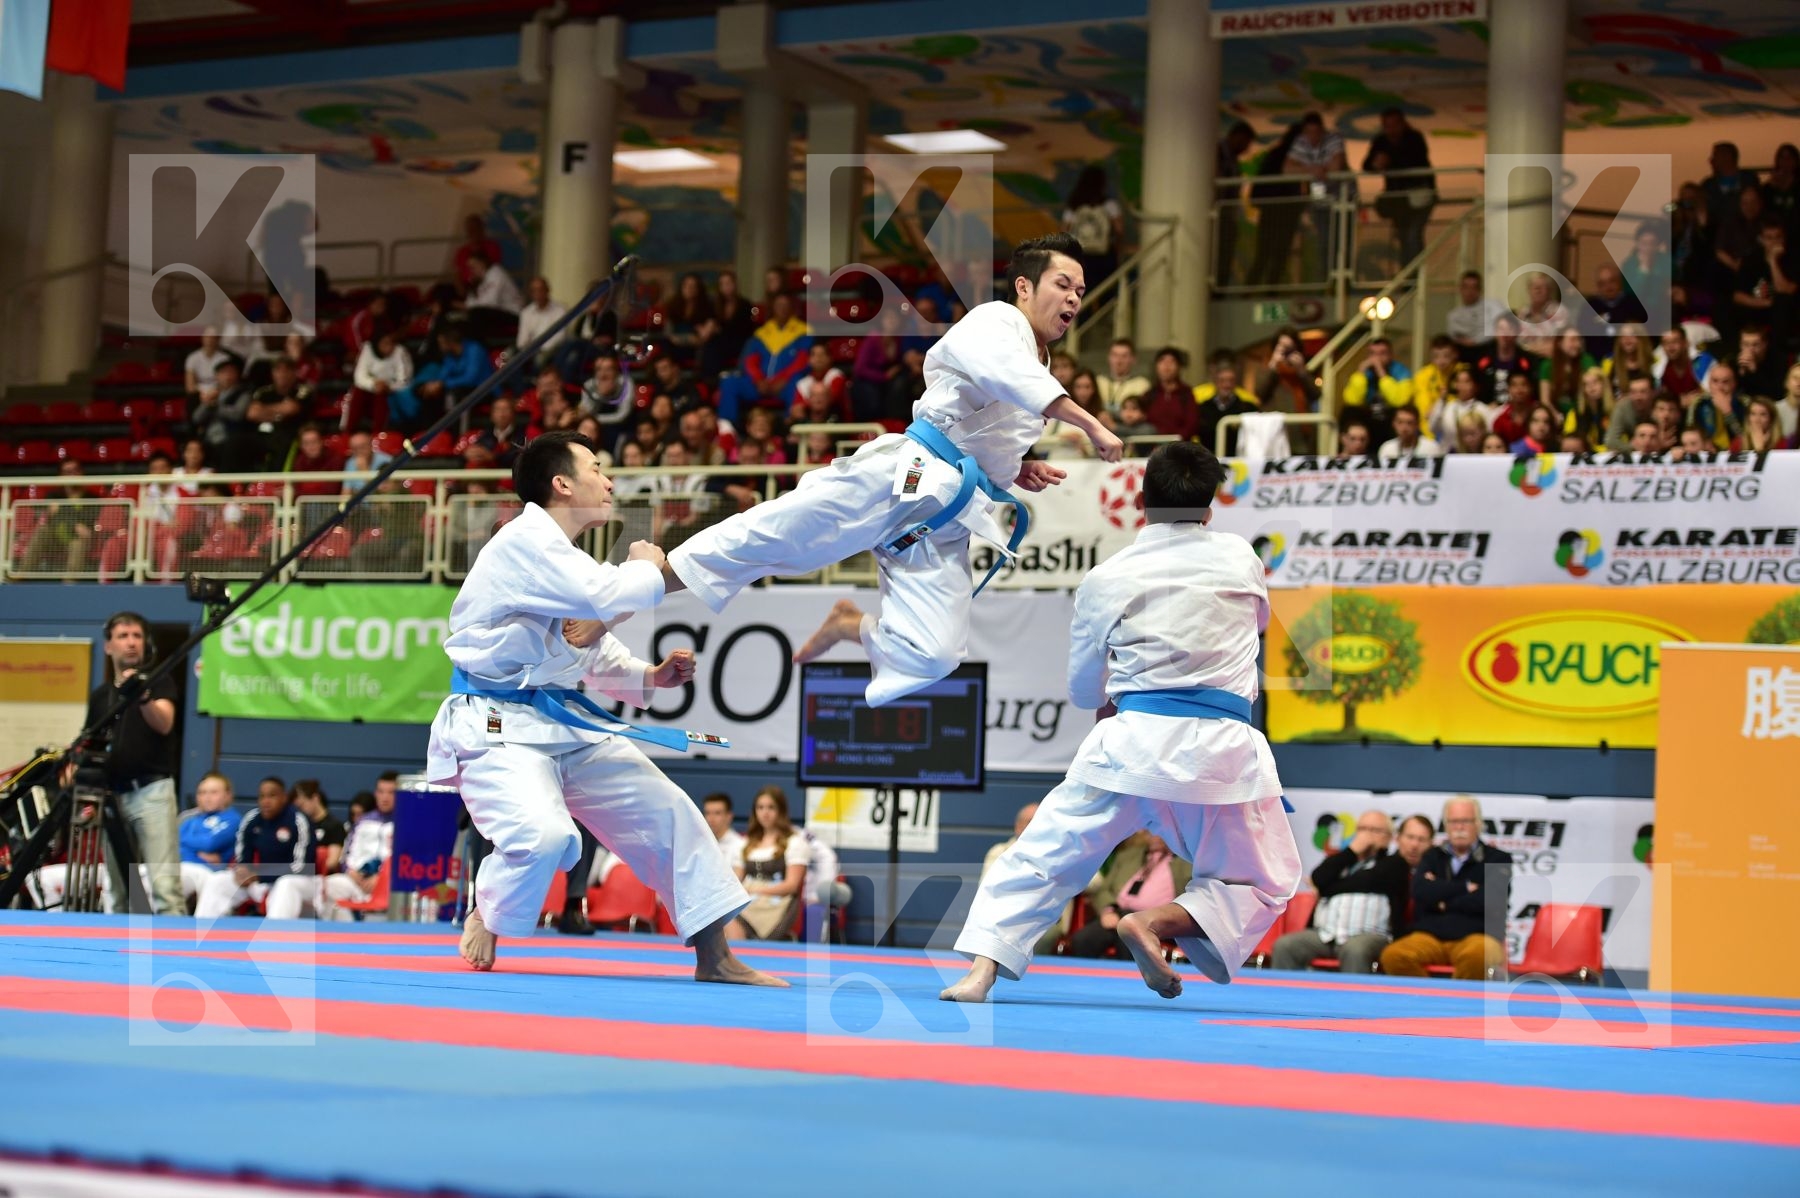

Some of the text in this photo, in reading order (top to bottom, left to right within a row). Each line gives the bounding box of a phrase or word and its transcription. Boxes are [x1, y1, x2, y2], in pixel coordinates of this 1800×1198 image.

[1220, 0, 1476, 33] RAUCHEN VERBOTEN
[562, 142, 588, 174] F
[1253, 482, 1440, 509] SALZBURG
[1560, 476, 1761, 503] SALZBURG
[967, 534, 1101, 580] ayashi
[1298, 530, 1490, 558] KARATE1
[1616, 528, 1800, 558] KARATE
[1286, 559, 1483, 586] SALZBURG
[1607, 559, 1800, 585] SALZBURG
[219, 671, 305, 702] learning
[311, 671, 340, 697] for
[576, 622, 794, 723] SO
[399, 853, 444, 881] Red
